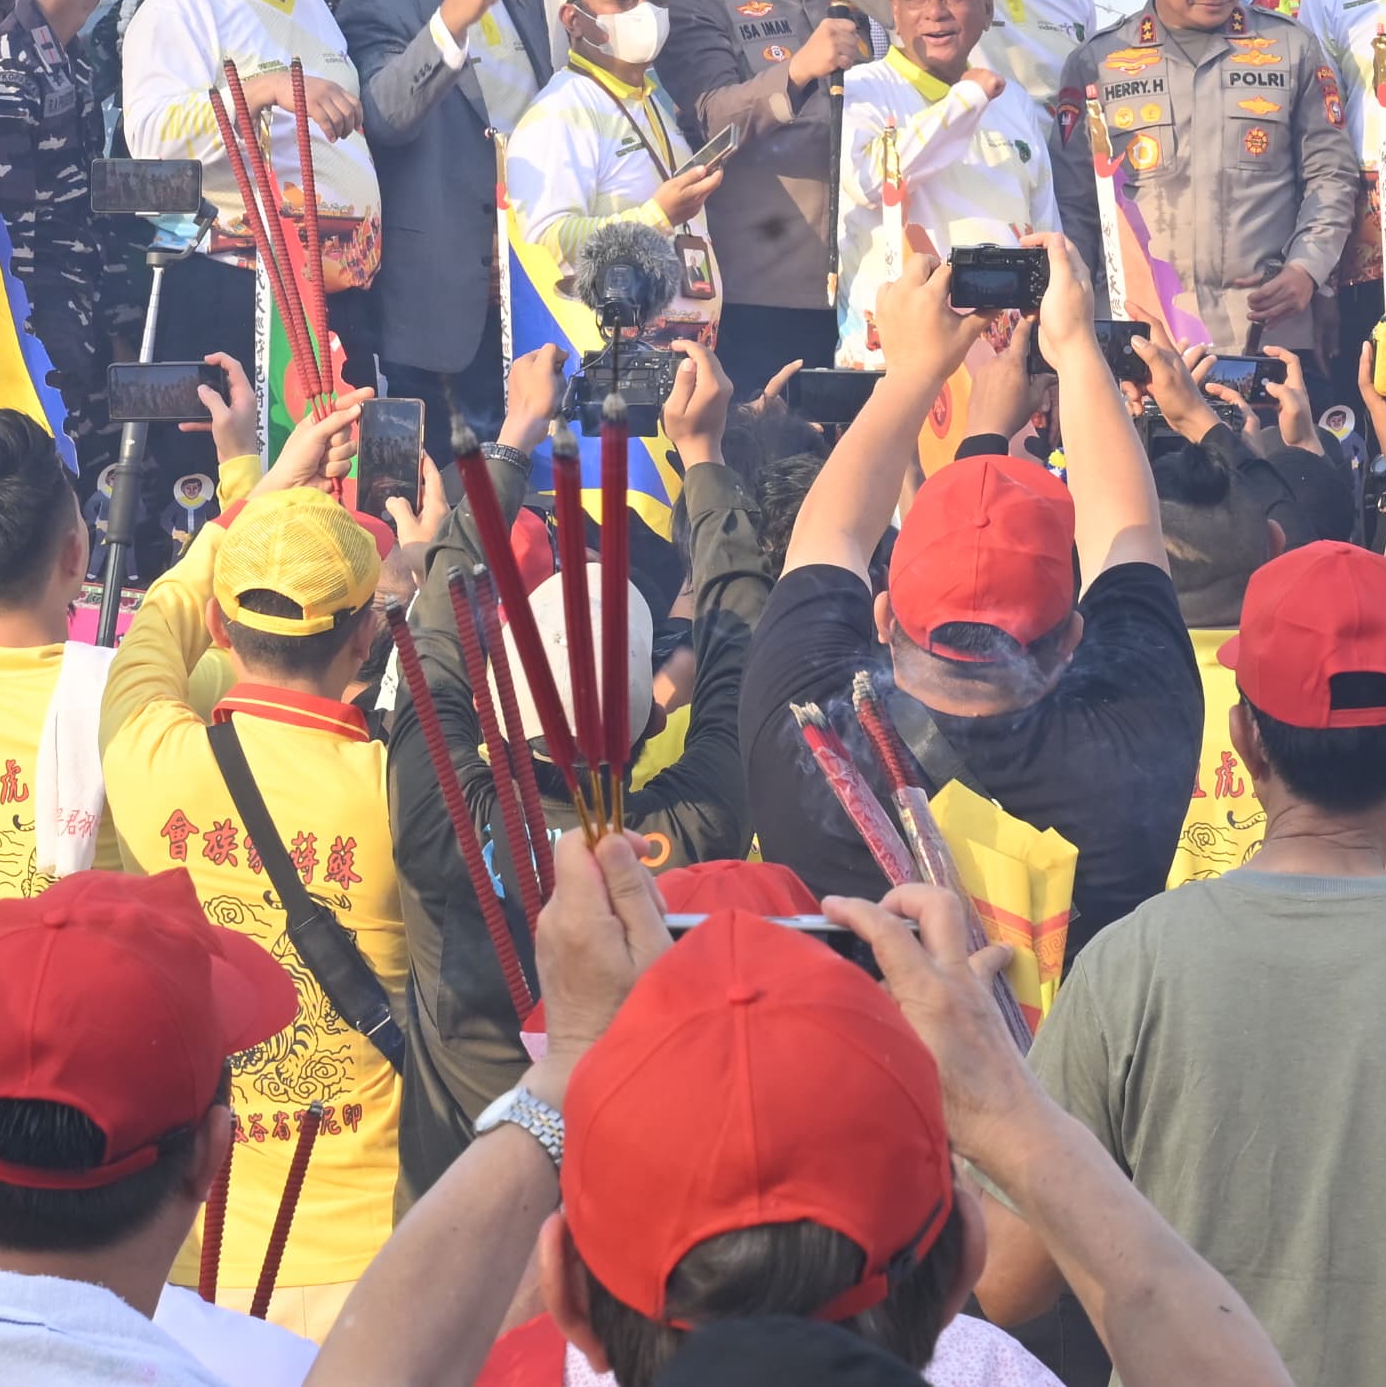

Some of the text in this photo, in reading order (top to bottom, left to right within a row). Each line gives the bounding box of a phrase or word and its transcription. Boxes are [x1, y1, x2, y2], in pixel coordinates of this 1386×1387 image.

[739, 20, 792, 40] ISA IMAM
[1229, 72, 1285, 87] POLRI
